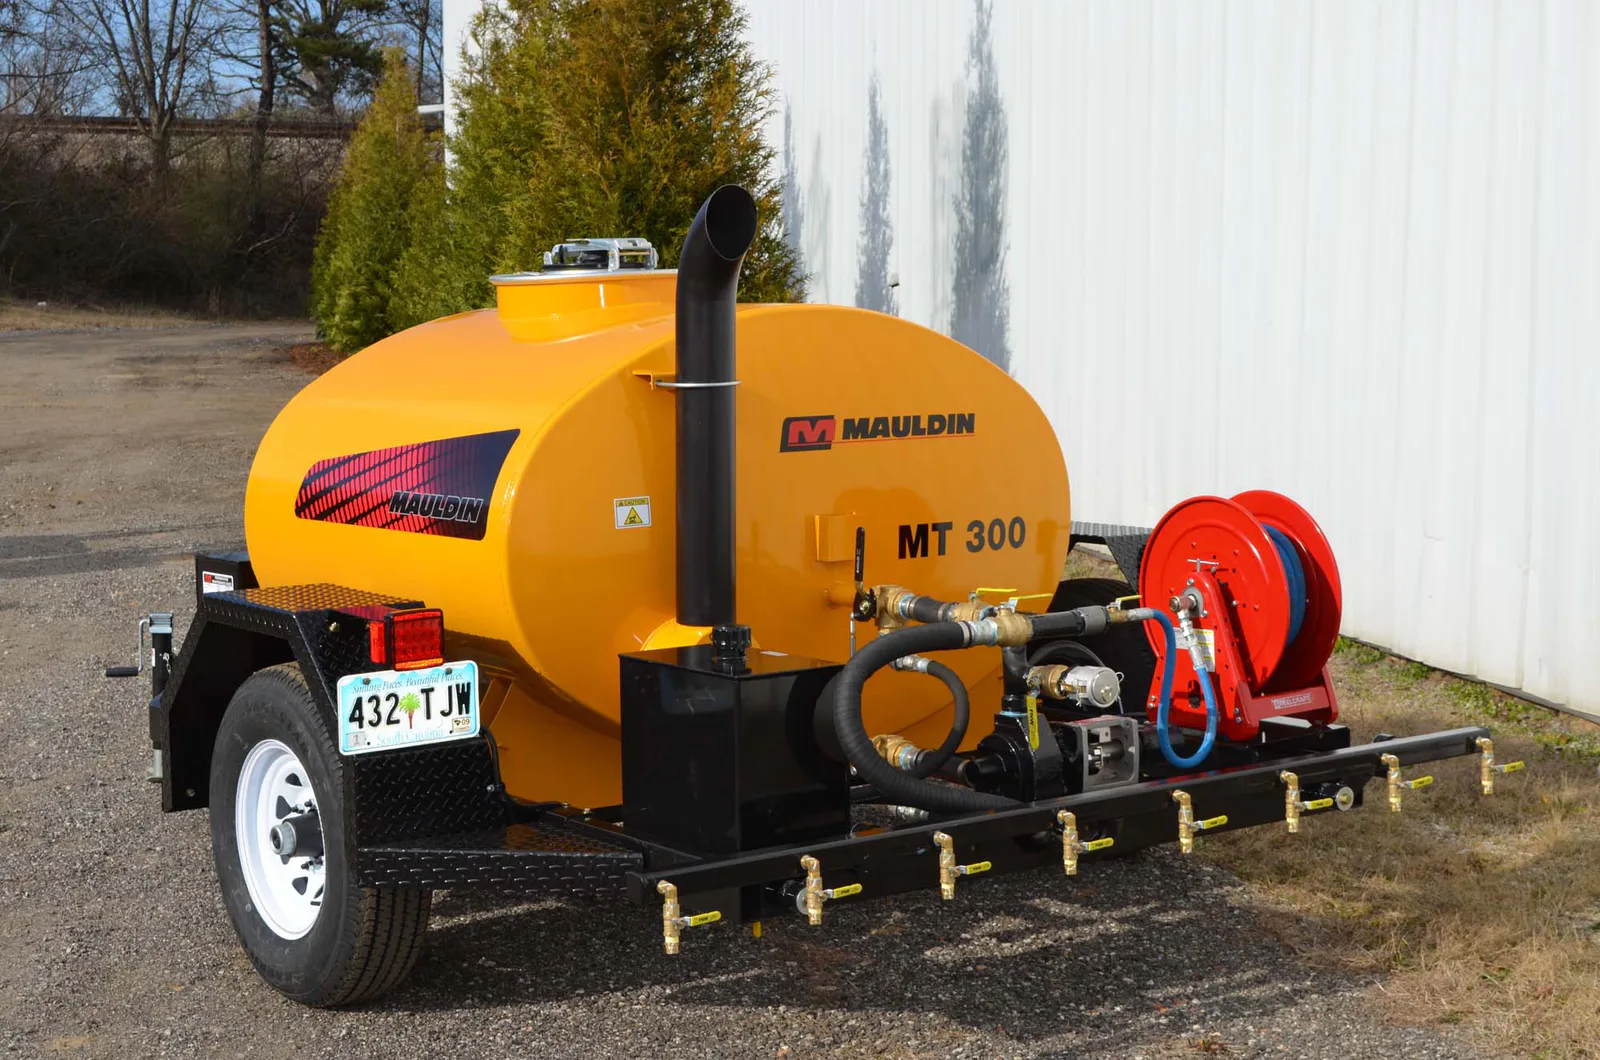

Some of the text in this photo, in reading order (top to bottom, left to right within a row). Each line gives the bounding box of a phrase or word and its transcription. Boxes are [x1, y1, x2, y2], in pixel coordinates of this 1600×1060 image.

[842, 413, 975, 440] MAULDIN
[389, 490, 484, 523] MAULDIN
[898, 516, 1026, 559] MT 300
[349, 682, 471, 729] 432 TJW
[377, 728, 444, 746] South Carolina
